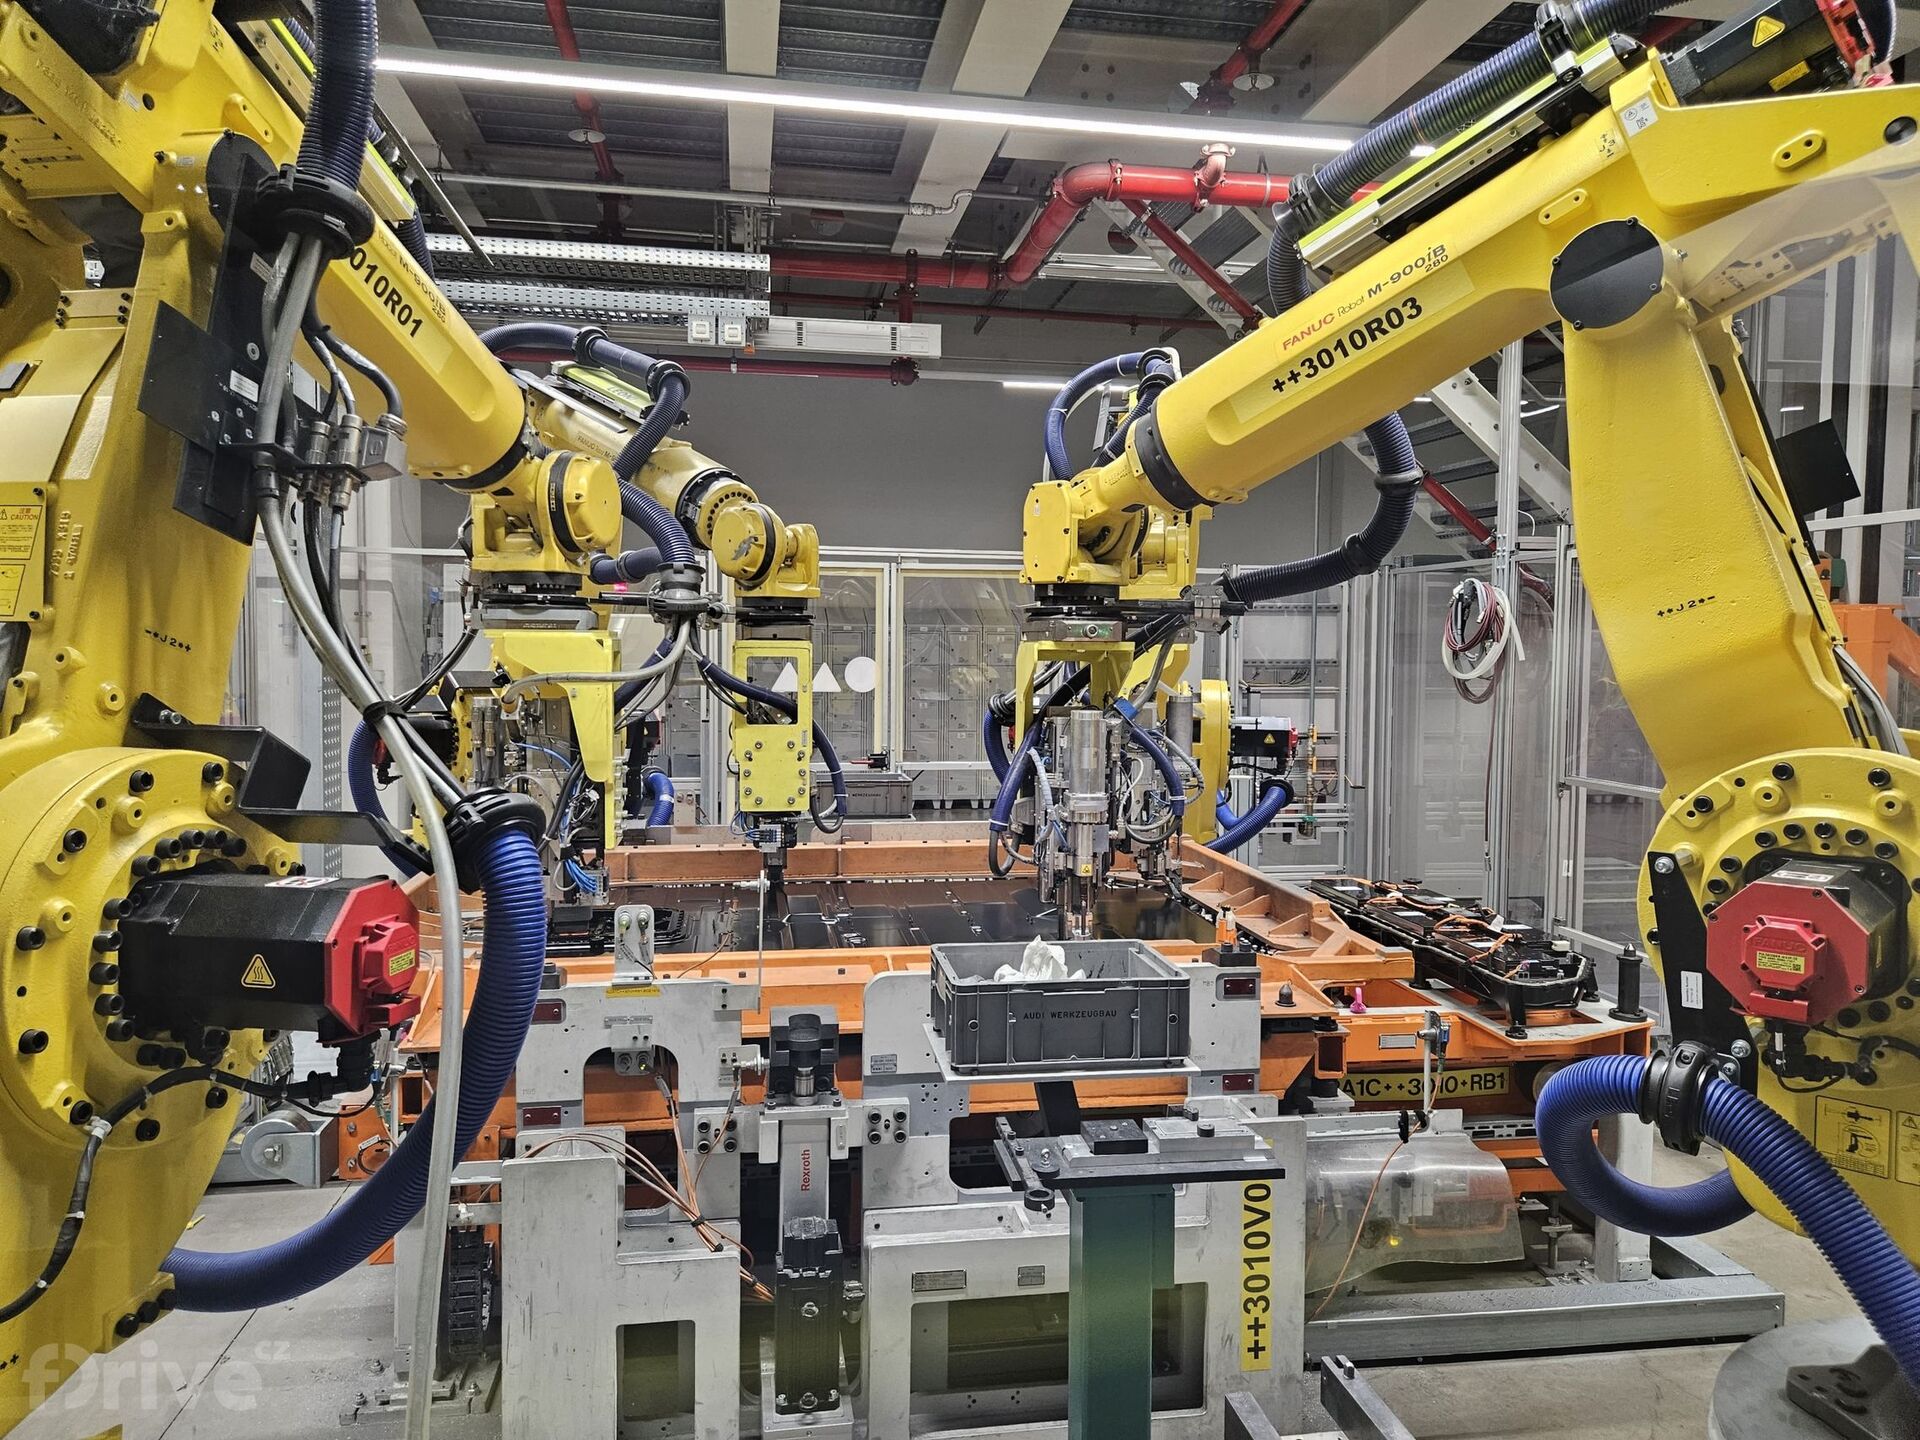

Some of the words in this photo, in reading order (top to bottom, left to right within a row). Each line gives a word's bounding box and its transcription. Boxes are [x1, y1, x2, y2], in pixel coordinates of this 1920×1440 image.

[1424, 254, 1449, 273] 280
[1272, 296, 1423, 393] ++3010R03
[1282, 312, 1335, 351] FANUC
[1337, 296, 1364, 317] Robot
[1023, 1011, 1045, 1020] AUDI
[1050, 1009, 1117, 1020] WERKZEUGBAU
[801, 1149, 810, 1191] Rexroth
